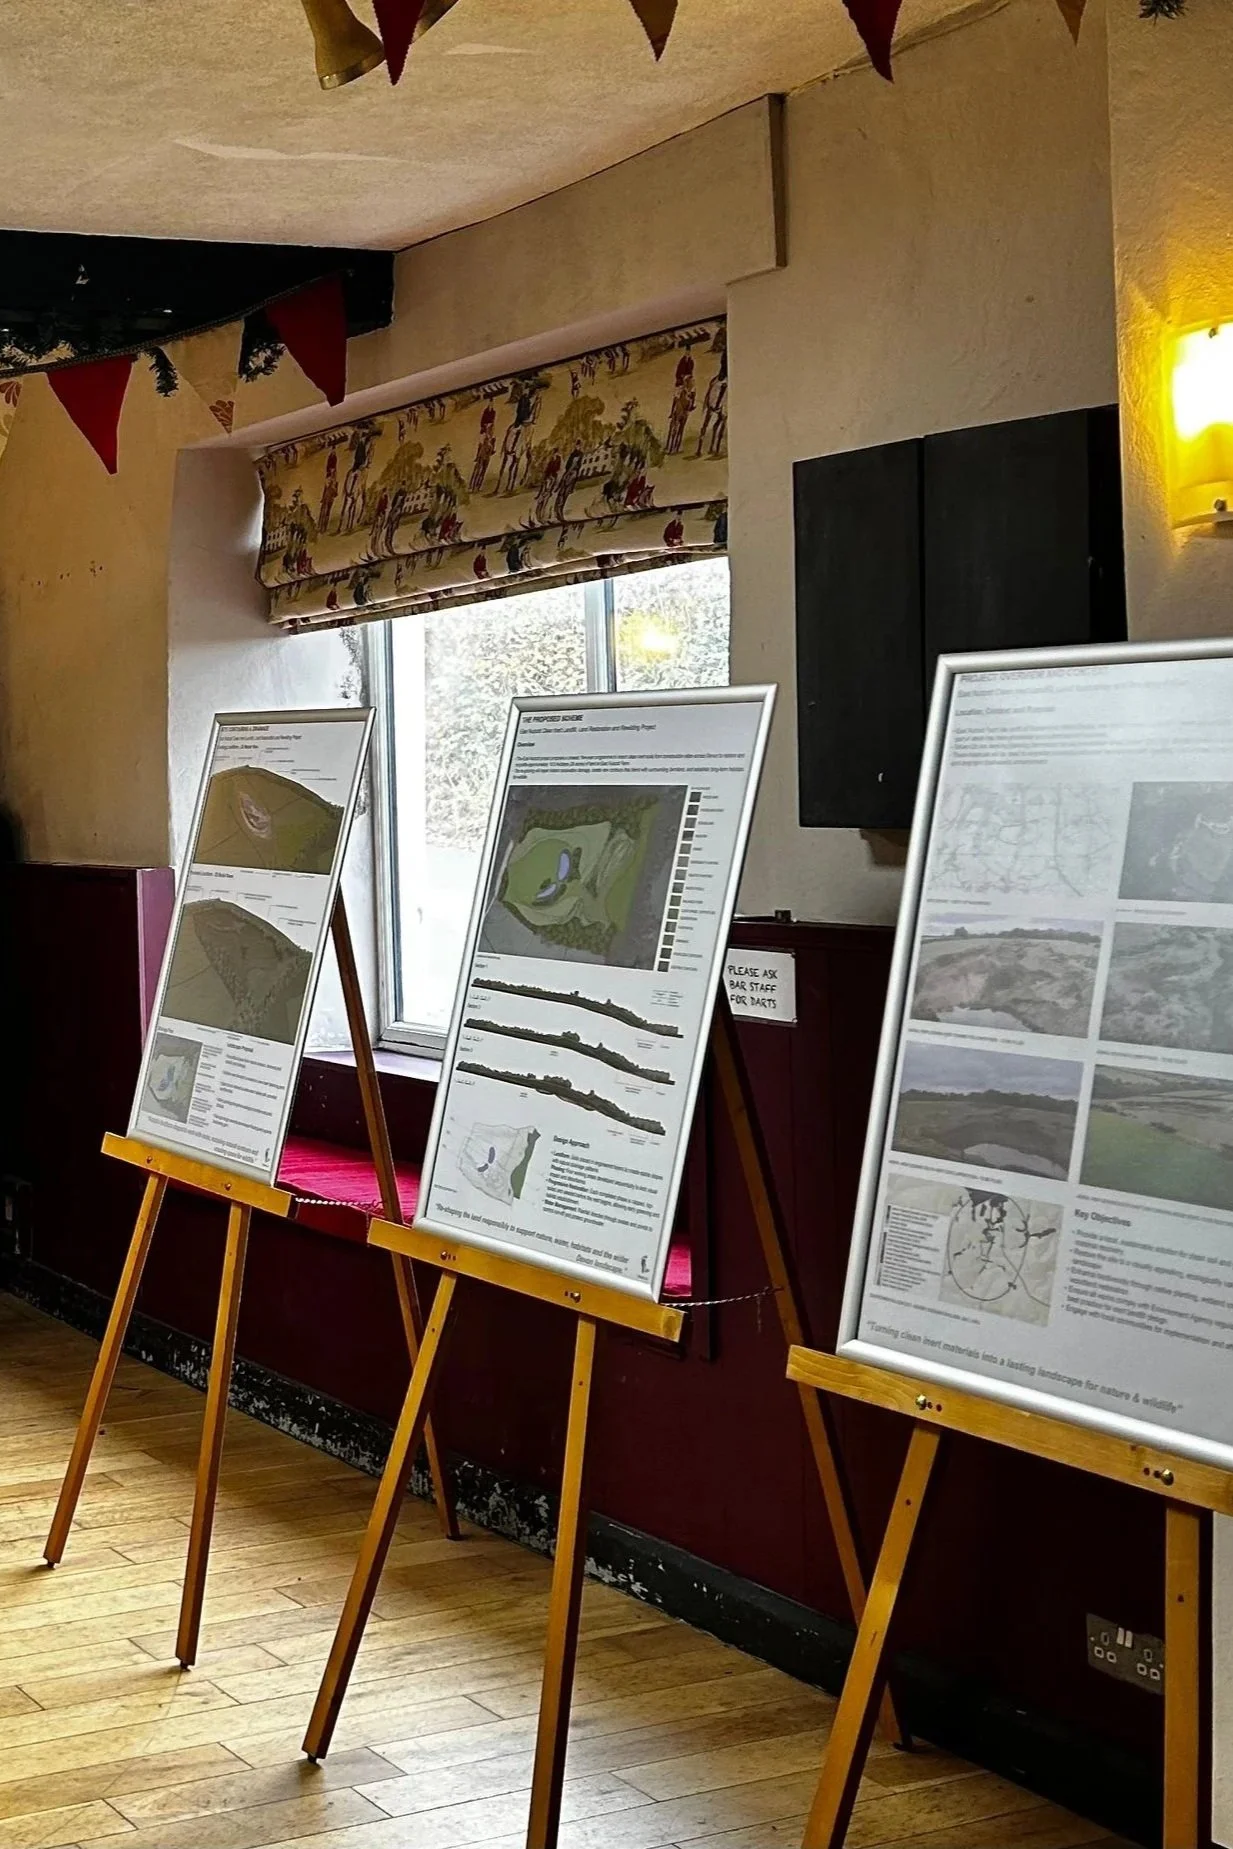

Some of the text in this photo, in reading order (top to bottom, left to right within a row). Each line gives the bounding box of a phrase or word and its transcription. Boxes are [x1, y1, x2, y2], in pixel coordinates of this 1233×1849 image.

[532, 715, 560, 723] PROPOSED
[561, 714, 584, 722] SCHEME
[727, 965, 779, 980] PLEASE ASK
[729, 980, 777, 993] BAR STAFF
[730, 994, 777, 1009] FOR DARTS
[569, 1138, 591, 1149] Approach
[1074, 1208, 1132, 1228] Key Objectives
[463, 1210, 471, 1220] the
[470, 1212, 481, 1223] land
[482, 1216, 509, 1233] responsibly
[516, 1224, 536, 1239] support
[536, 1231, 553, 1243] nature,
[570, 1238, 592, 1253] habitats
[592, 1246, 603, 1257] and
[603, 1249, 612, 1259] the
[576, 1253, 594, 1267] Devon
[900, 1327, 922, 1345] clean
[922, 1333, 942, 1351] inert
[942, 1339, 981, 1361] materials
[981, 1350, 999, 1367] into
[999, 1358, 1006, 1368] a
[1006, 1356, 1036, 1378] lasting
[1037, 1364, 1084, 1391] landscape
[1085, 1378, 1099, 1394] for
[1100, 1383, 1130, 1402] nature
[1132, 1391, 1141, 1404] &
[1141, 1395, 1184, 1415] wildlife”
